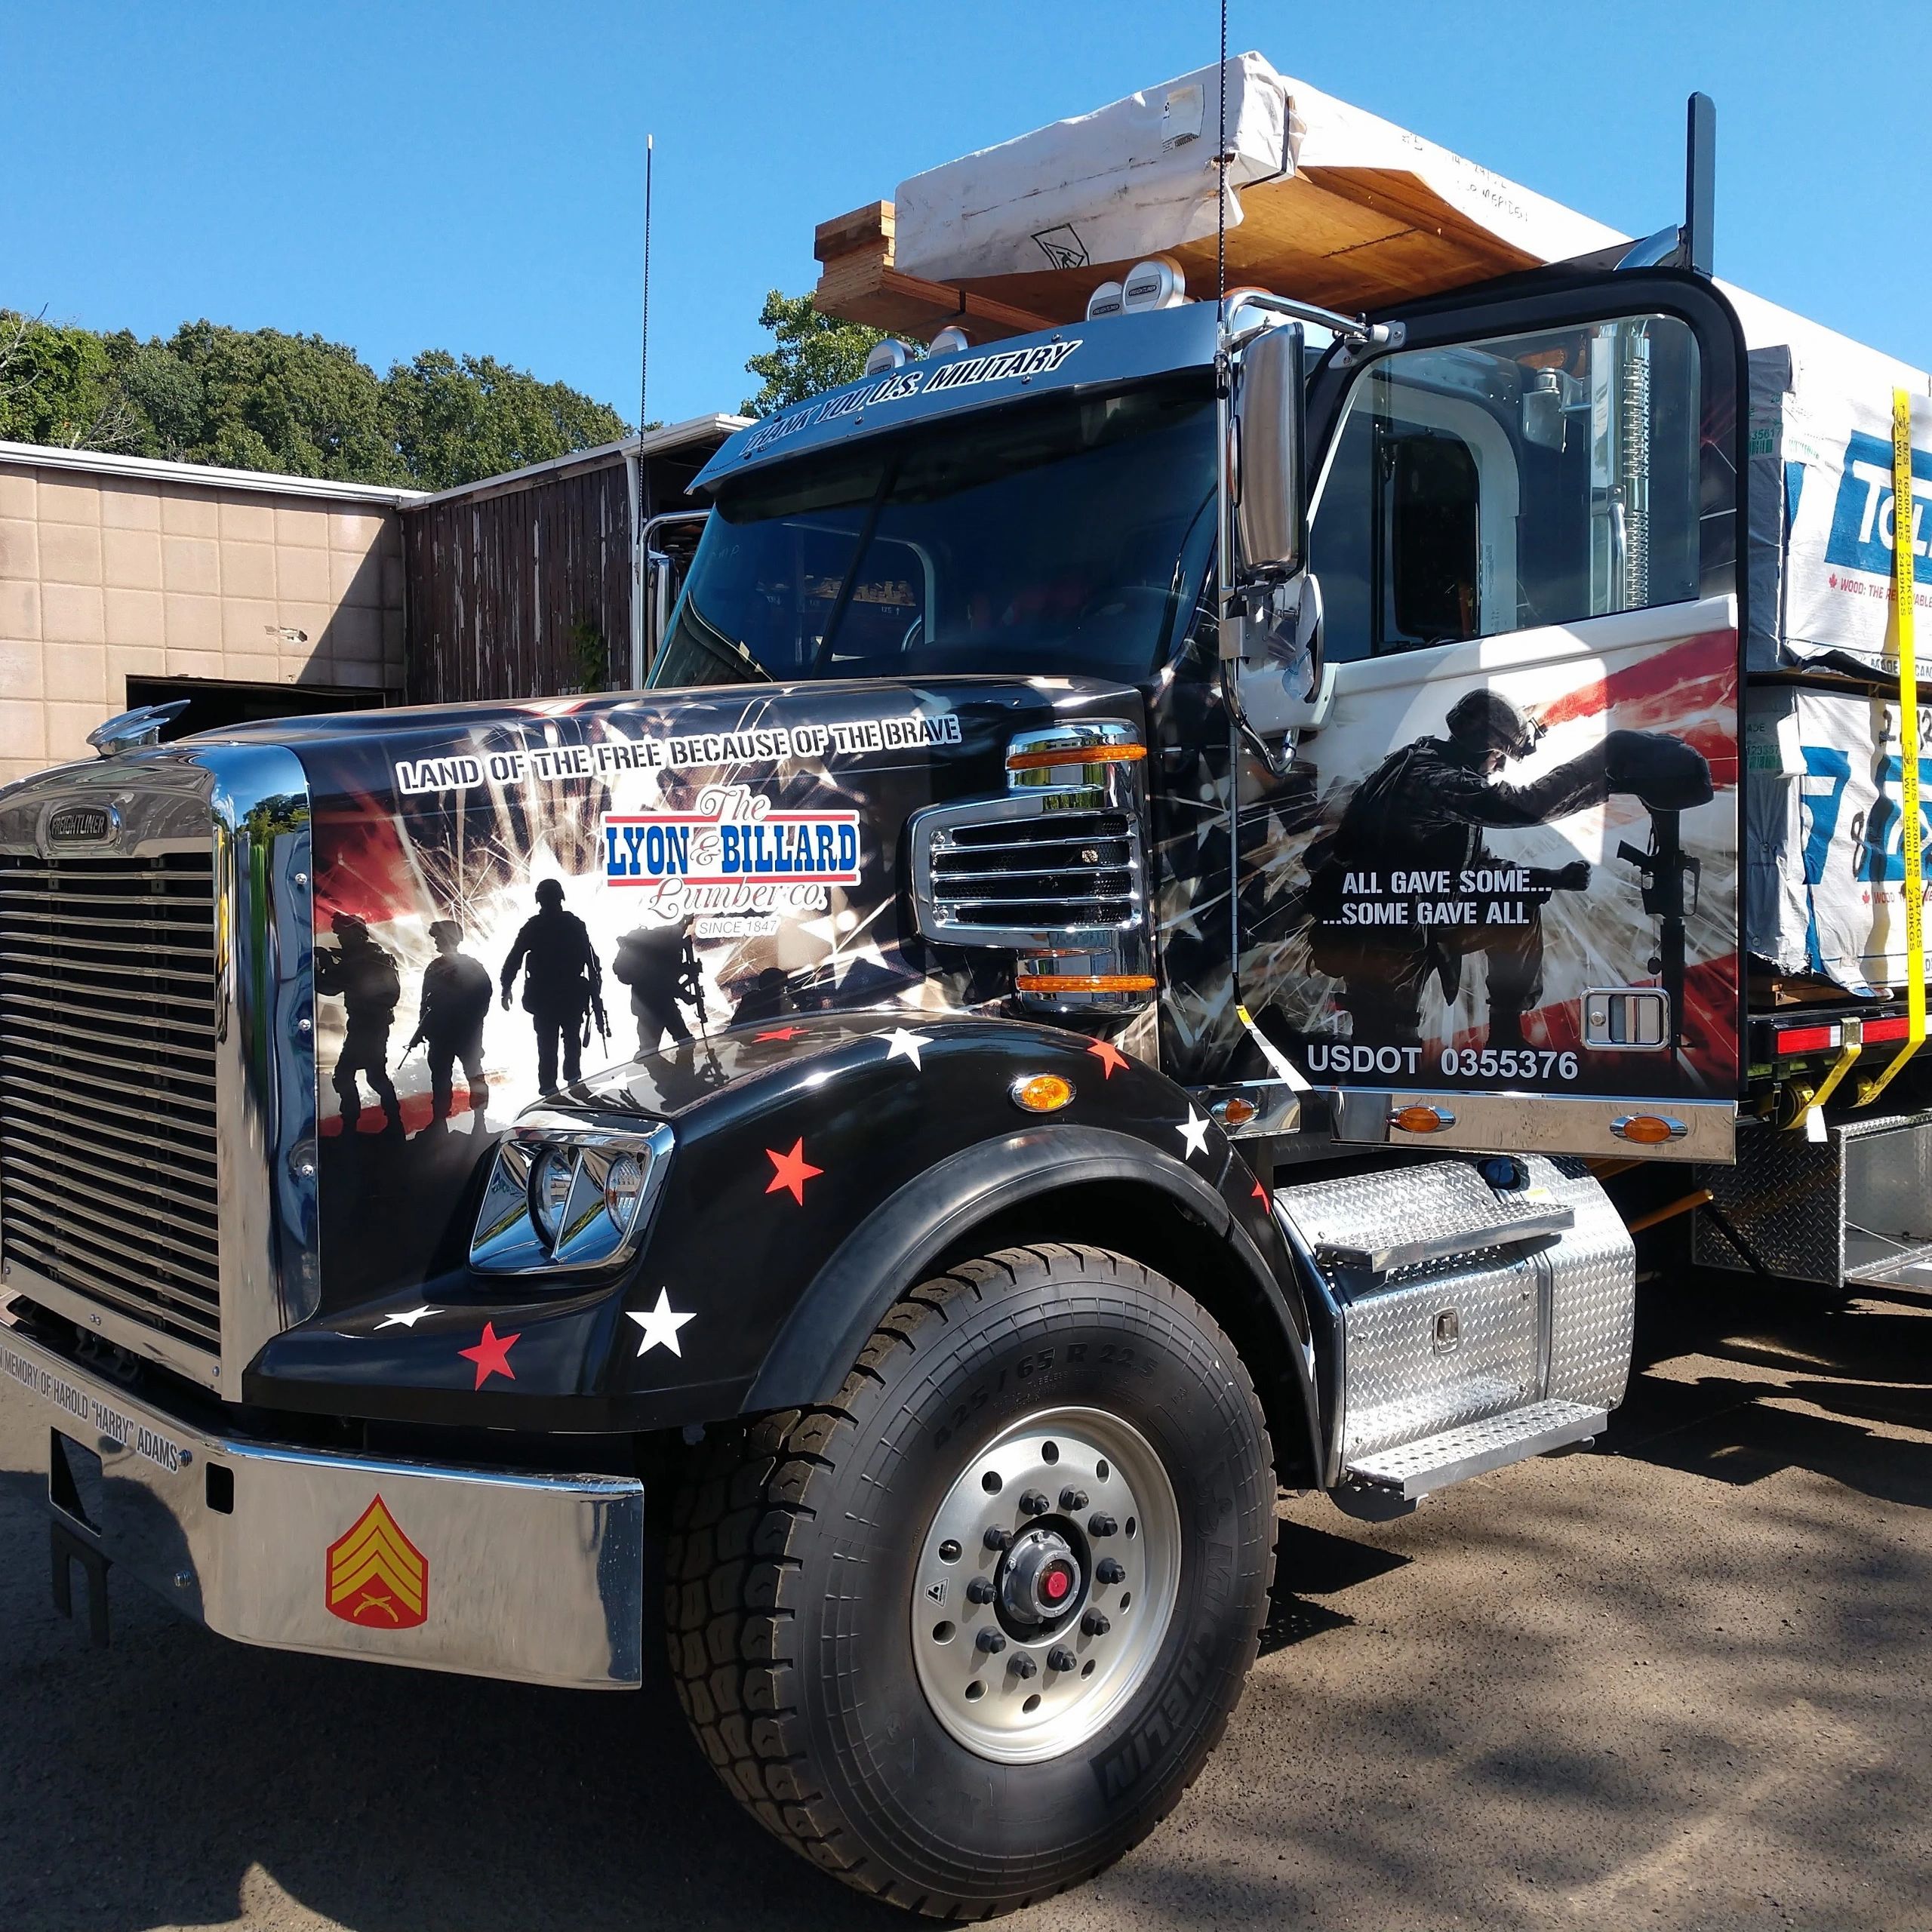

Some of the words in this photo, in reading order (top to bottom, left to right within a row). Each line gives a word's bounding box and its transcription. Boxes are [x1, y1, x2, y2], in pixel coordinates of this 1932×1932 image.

[740, 405, 822, 456] THANK
[814, 383, 875, 423] YOU
[922, 340, 1084, 393] MILITARY
[1853, 460, 1932, 558] TOL
[1841, 577, 1866, 595] WOOD:
[1869, 584, 1884, 598] THE
[401, 758, 479, 790] LAND
[491, 754, 525, 780] OF
[533, 749, 589, 777] THE
[597, 743, 663, 772] FREE
[669, 732, 787, 764] BECAUSE
[794, 728, 829, 753] OF
[832, 721, 879, 749] THE
[885, 717, 959, 745] BRAVE
[700, 789, 767, 822] The
[51, 813, 106, 835] FREIGHTLINER
[606, 825, 689, 875] LYON
[690, 835, 721, 866] &
[721, 824, 857, 873] BILLARD
[648, 876, 783, 919] Lumber
[1342, 872, 1383, 894] ALL
[1392, 871, 1450, 894] GAVE
[1460, 870, 1552, 893] SOME...
[700, 920, 743, 935] SINCE
[746, 919, 777, 933] 1847
[1323, 903, 1408, 924] ...SOME
[1418, 903, 1477, 924] GAVE
[1486, 902, 1530, 924] ALL
[1307, 1045, 1423, 1074] USDOT
[1441, 1048, 1579, 1080] 0355376
[5, 1349, 38, 1389] MEMORY
[41, 1371, 51, 1397] OF
[54, 1379, 88, 1420] HAROLD
[137, 1427, 177, 1472] ADAMS
